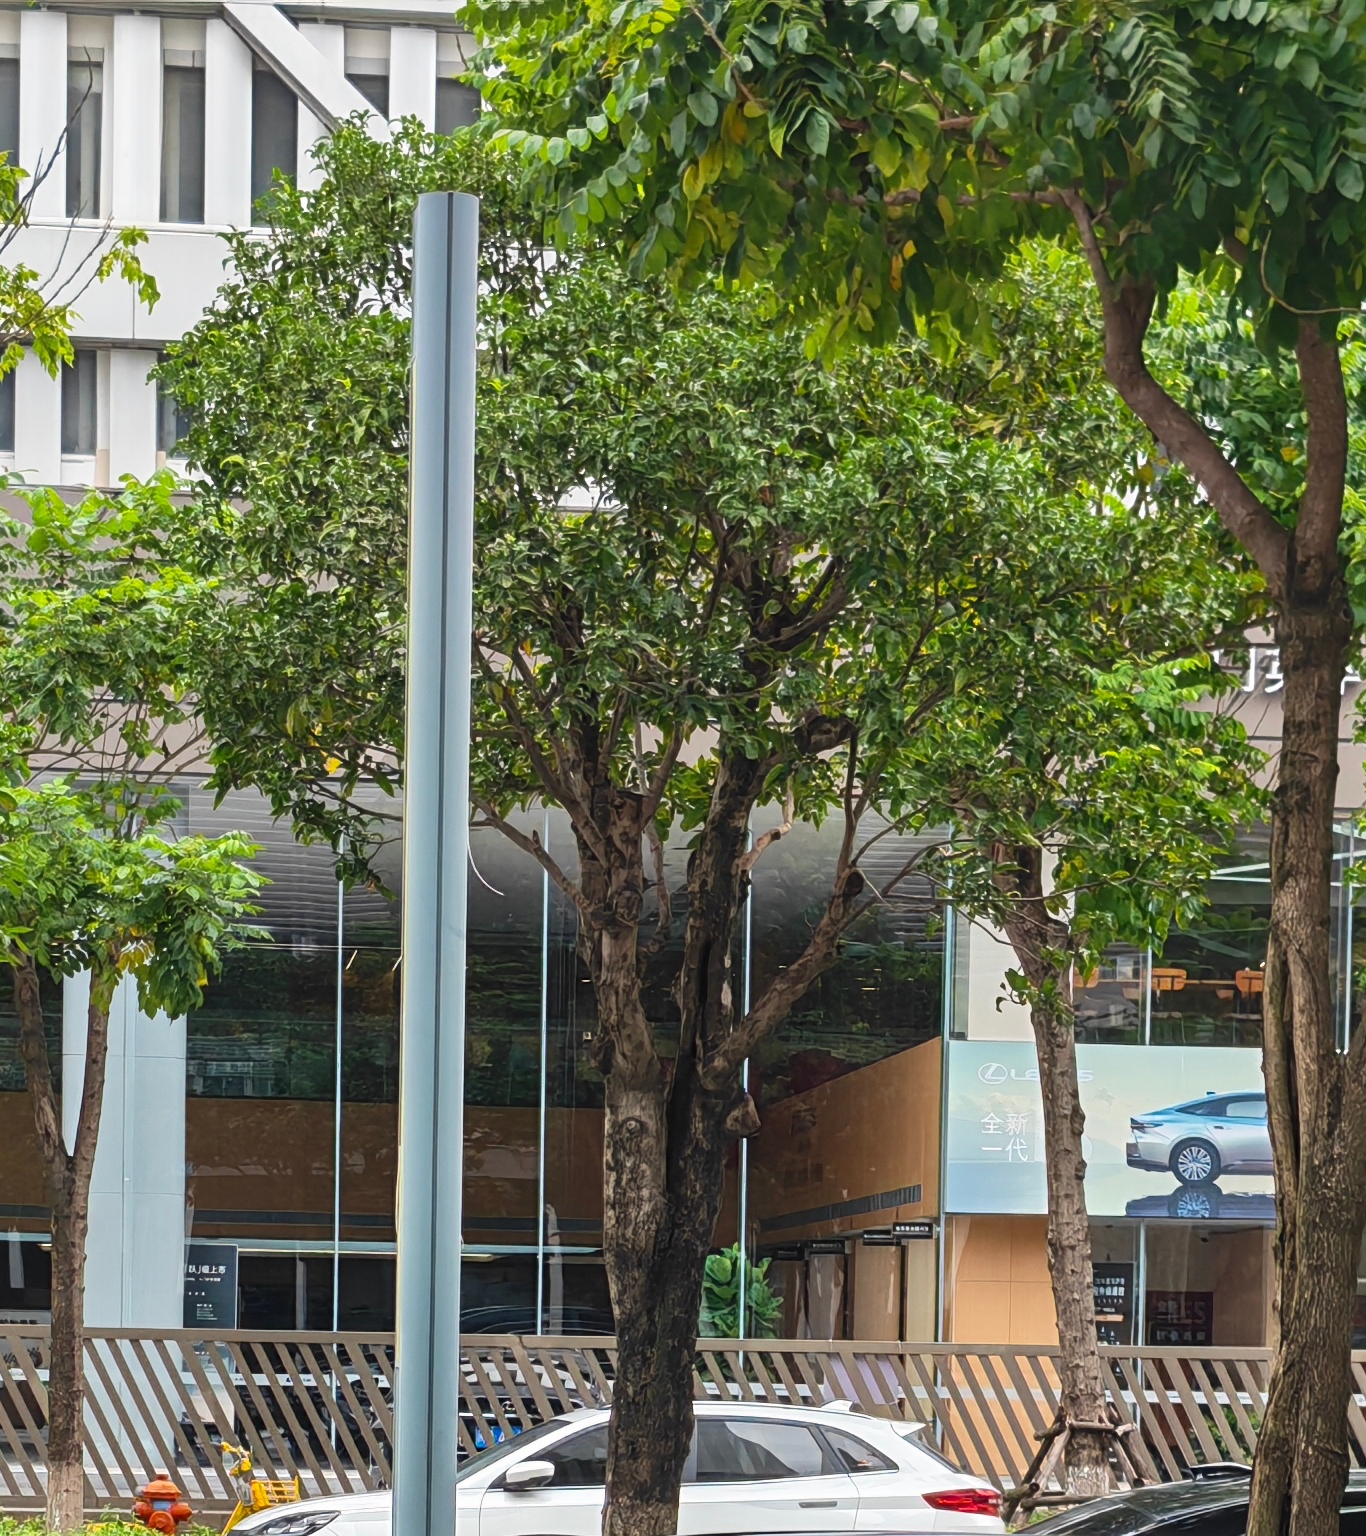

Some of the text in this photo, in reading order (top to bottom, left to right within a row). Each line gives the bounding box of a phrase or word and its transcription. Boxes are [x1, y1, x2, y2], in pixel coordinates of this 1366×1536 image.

[1010, 1068, 1094, 1081] LES
[980, 1111, 1030, 1136] 全新
[981, 1137, 1029, 1162] 一代
